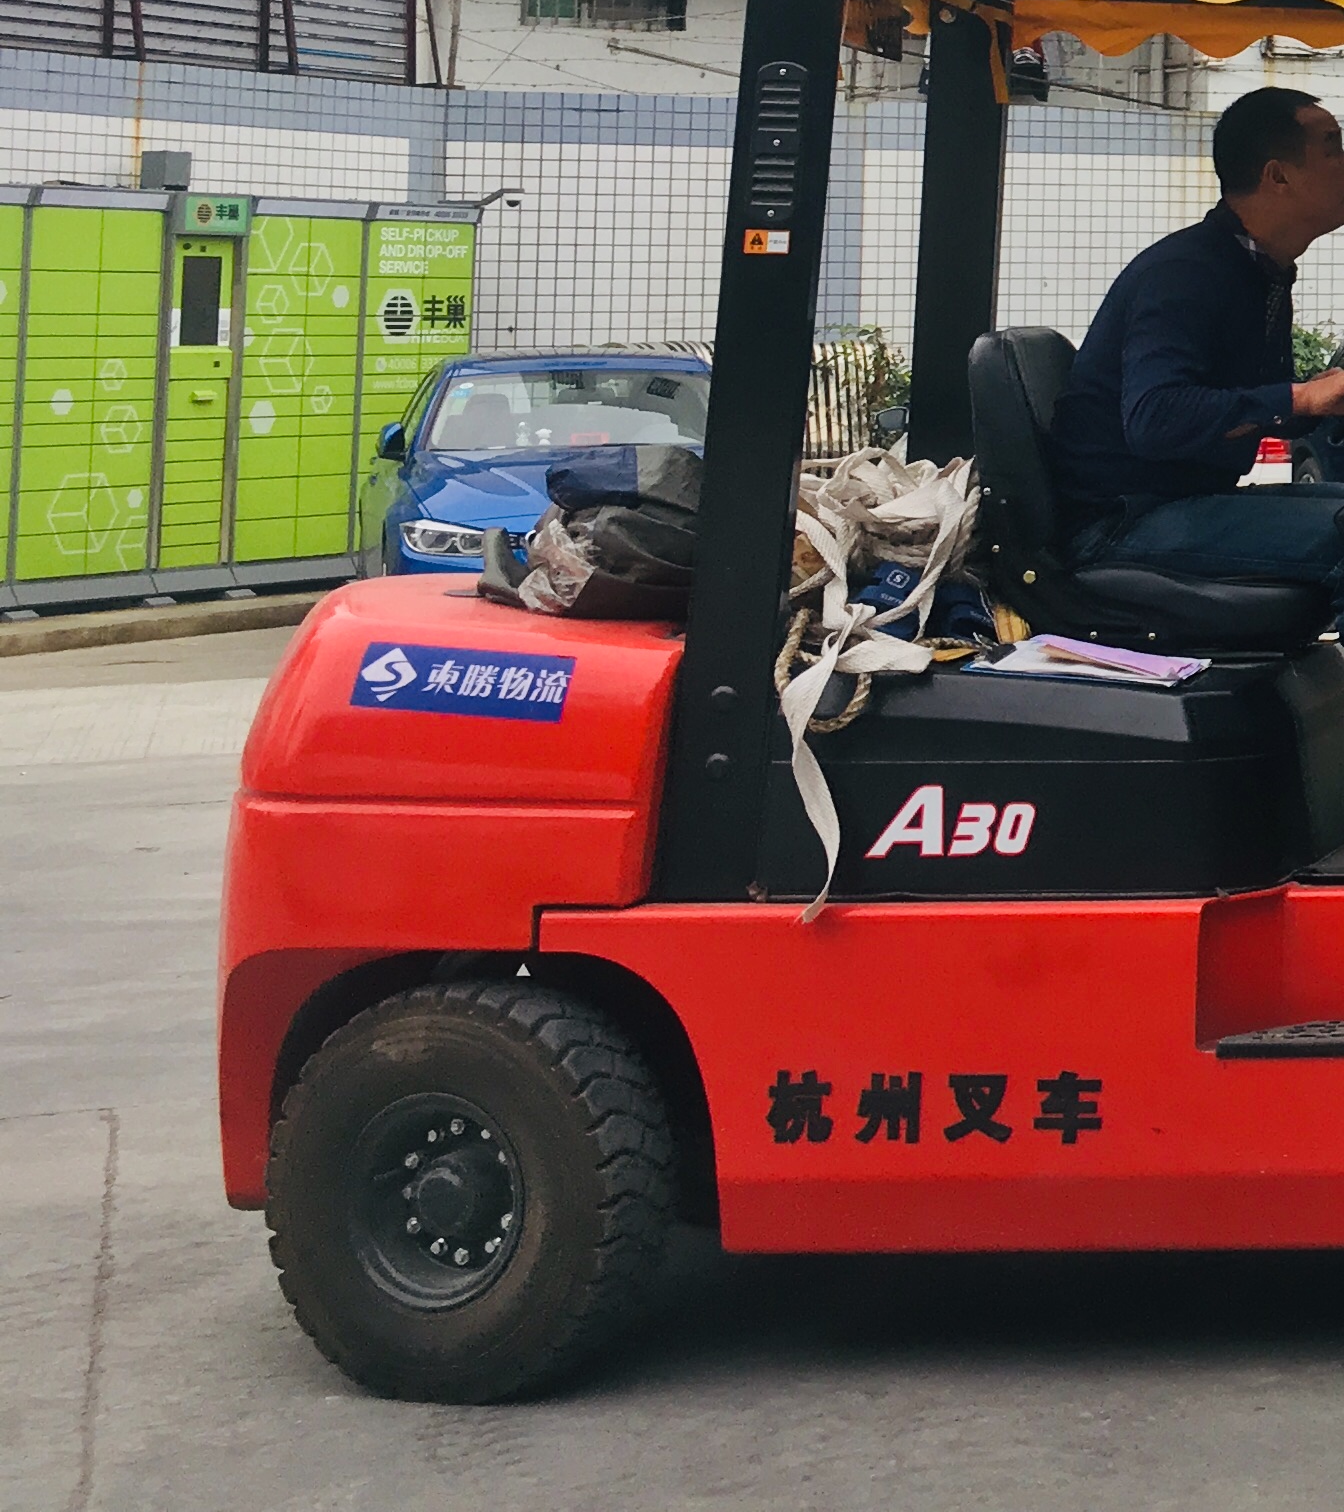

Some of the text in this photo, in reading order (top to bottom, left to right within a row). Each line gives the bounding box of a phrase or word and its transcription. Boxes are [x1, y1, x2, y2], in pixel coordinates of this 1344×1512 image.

[379, 245, 468, 258] AND DROP-OFF
[379, 261, 428, 274] SERVICE
[423, 295, 466, 328] 丰巢
[421, 659, 573, 704] 東勝物流
[864, 784, 1036, 859] A30
[766, 1069, 1103, 1144] 杭州叉车
